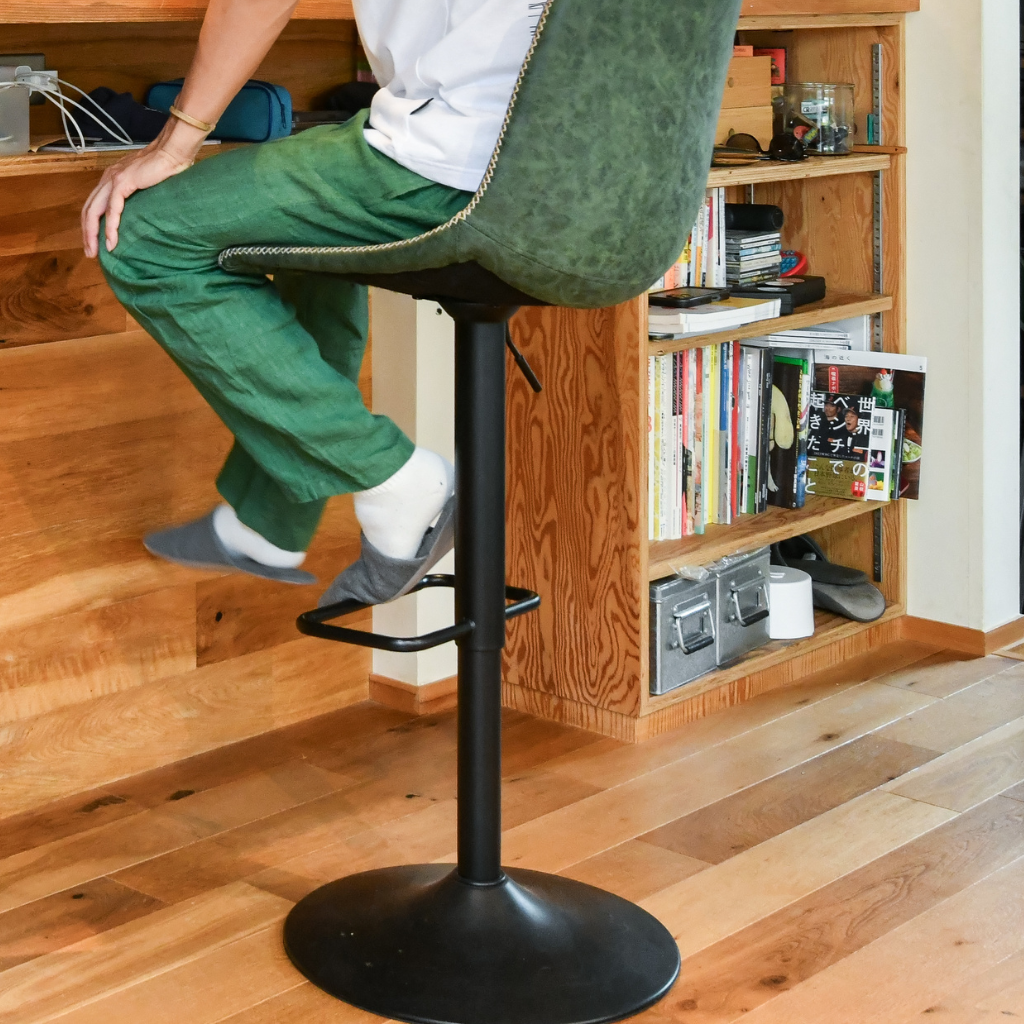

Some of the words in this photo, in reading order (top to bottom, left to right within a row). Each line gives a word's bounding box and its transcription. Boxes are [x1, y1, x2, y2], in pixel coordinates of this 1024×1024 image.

[805, 392, 825, 495] 起きたこと
[829, 396, 852, 475] ベンチで
[852, 396, 876, 477] 世界一の
